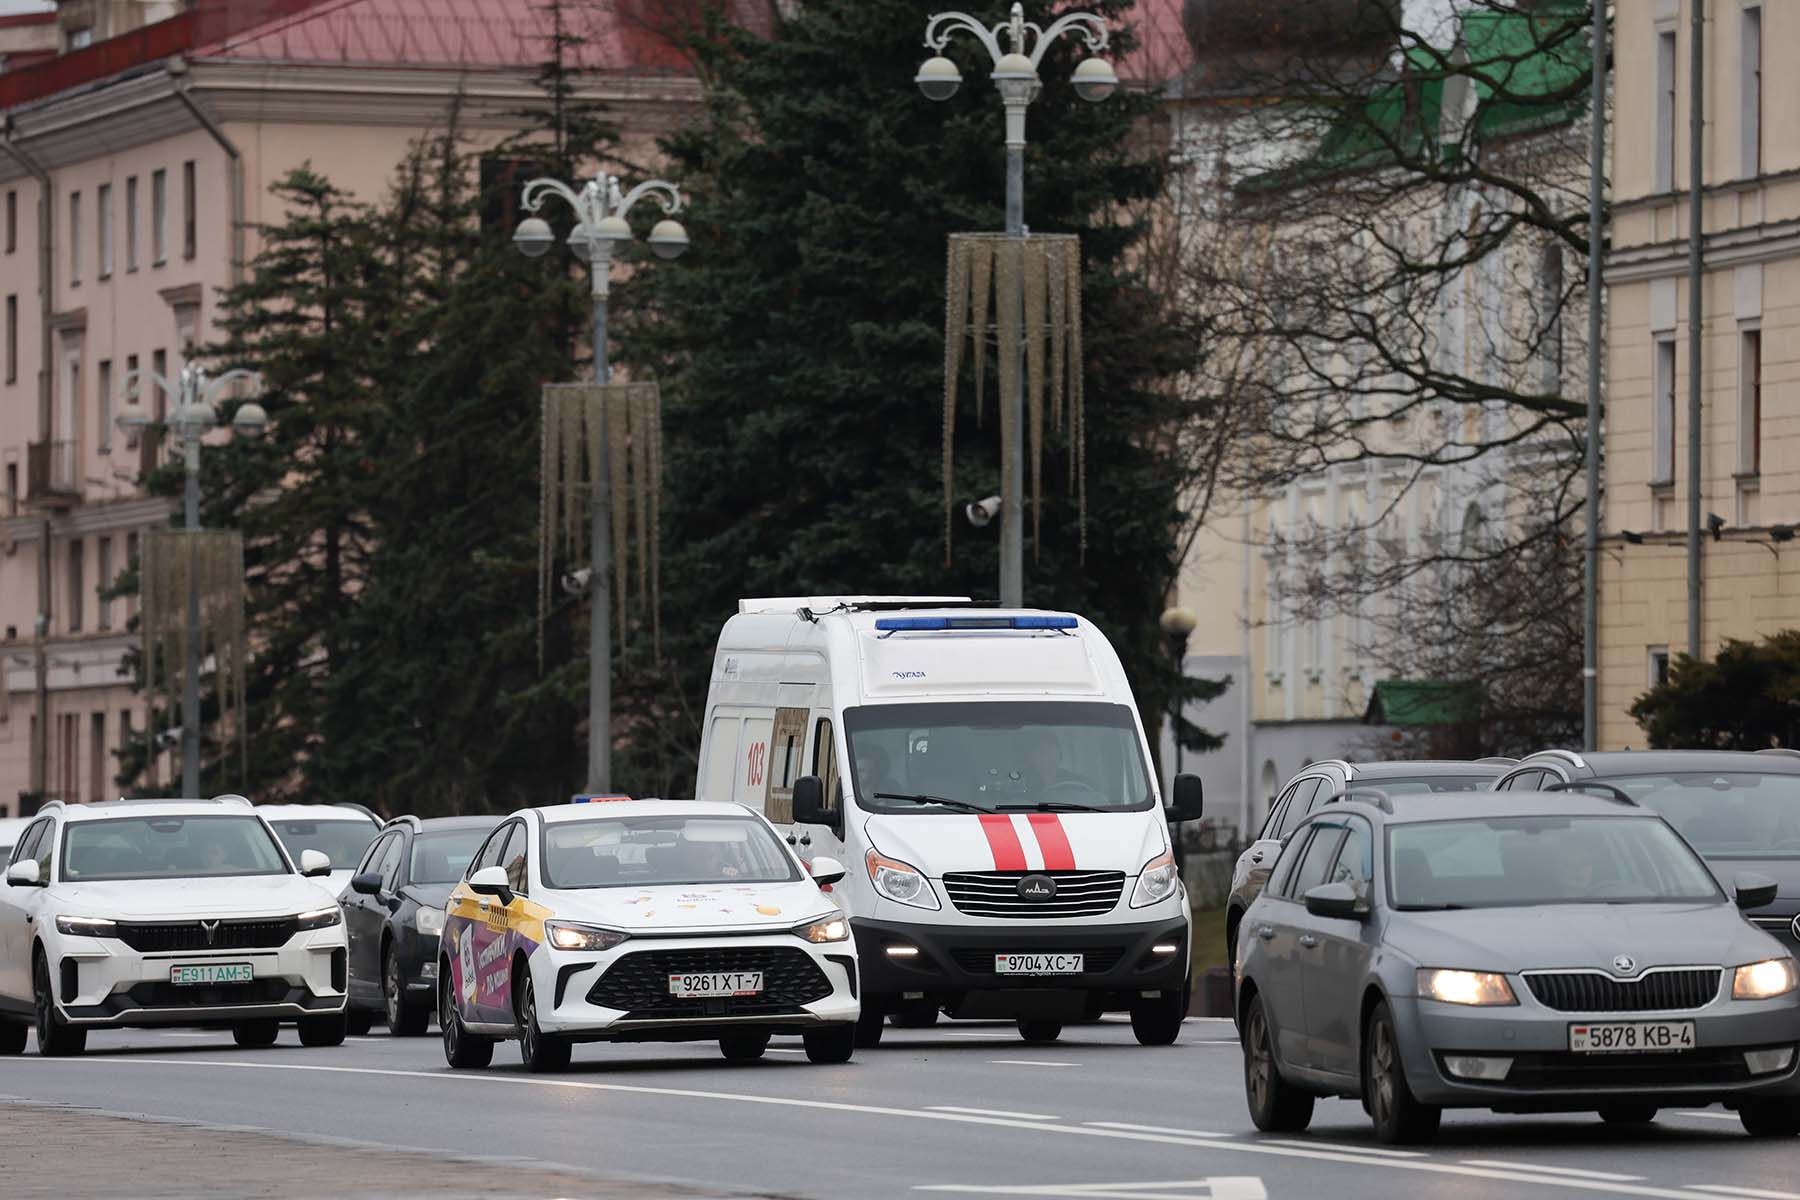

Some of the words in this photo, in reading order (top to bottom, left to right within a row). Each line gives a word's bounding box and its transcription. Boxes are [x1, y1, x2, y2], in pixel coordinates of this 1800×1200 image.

[747, 741, 765, 787] 103
[1008, 955, 1042, 971] 9704
[1044, 955, 1081, 971] XC-7
[181, 967, 213, 982] E911
[216, 966, 250, 981] AM-5
[683, 975, 717, 991] 9261
[722, 973, 761, 991] XT-7
[1574, 1039, 1585, 1048] BY
[1590, 1027, 1637, 1047] 5878
[1643, 1025, 1691, 1047] KB-4
